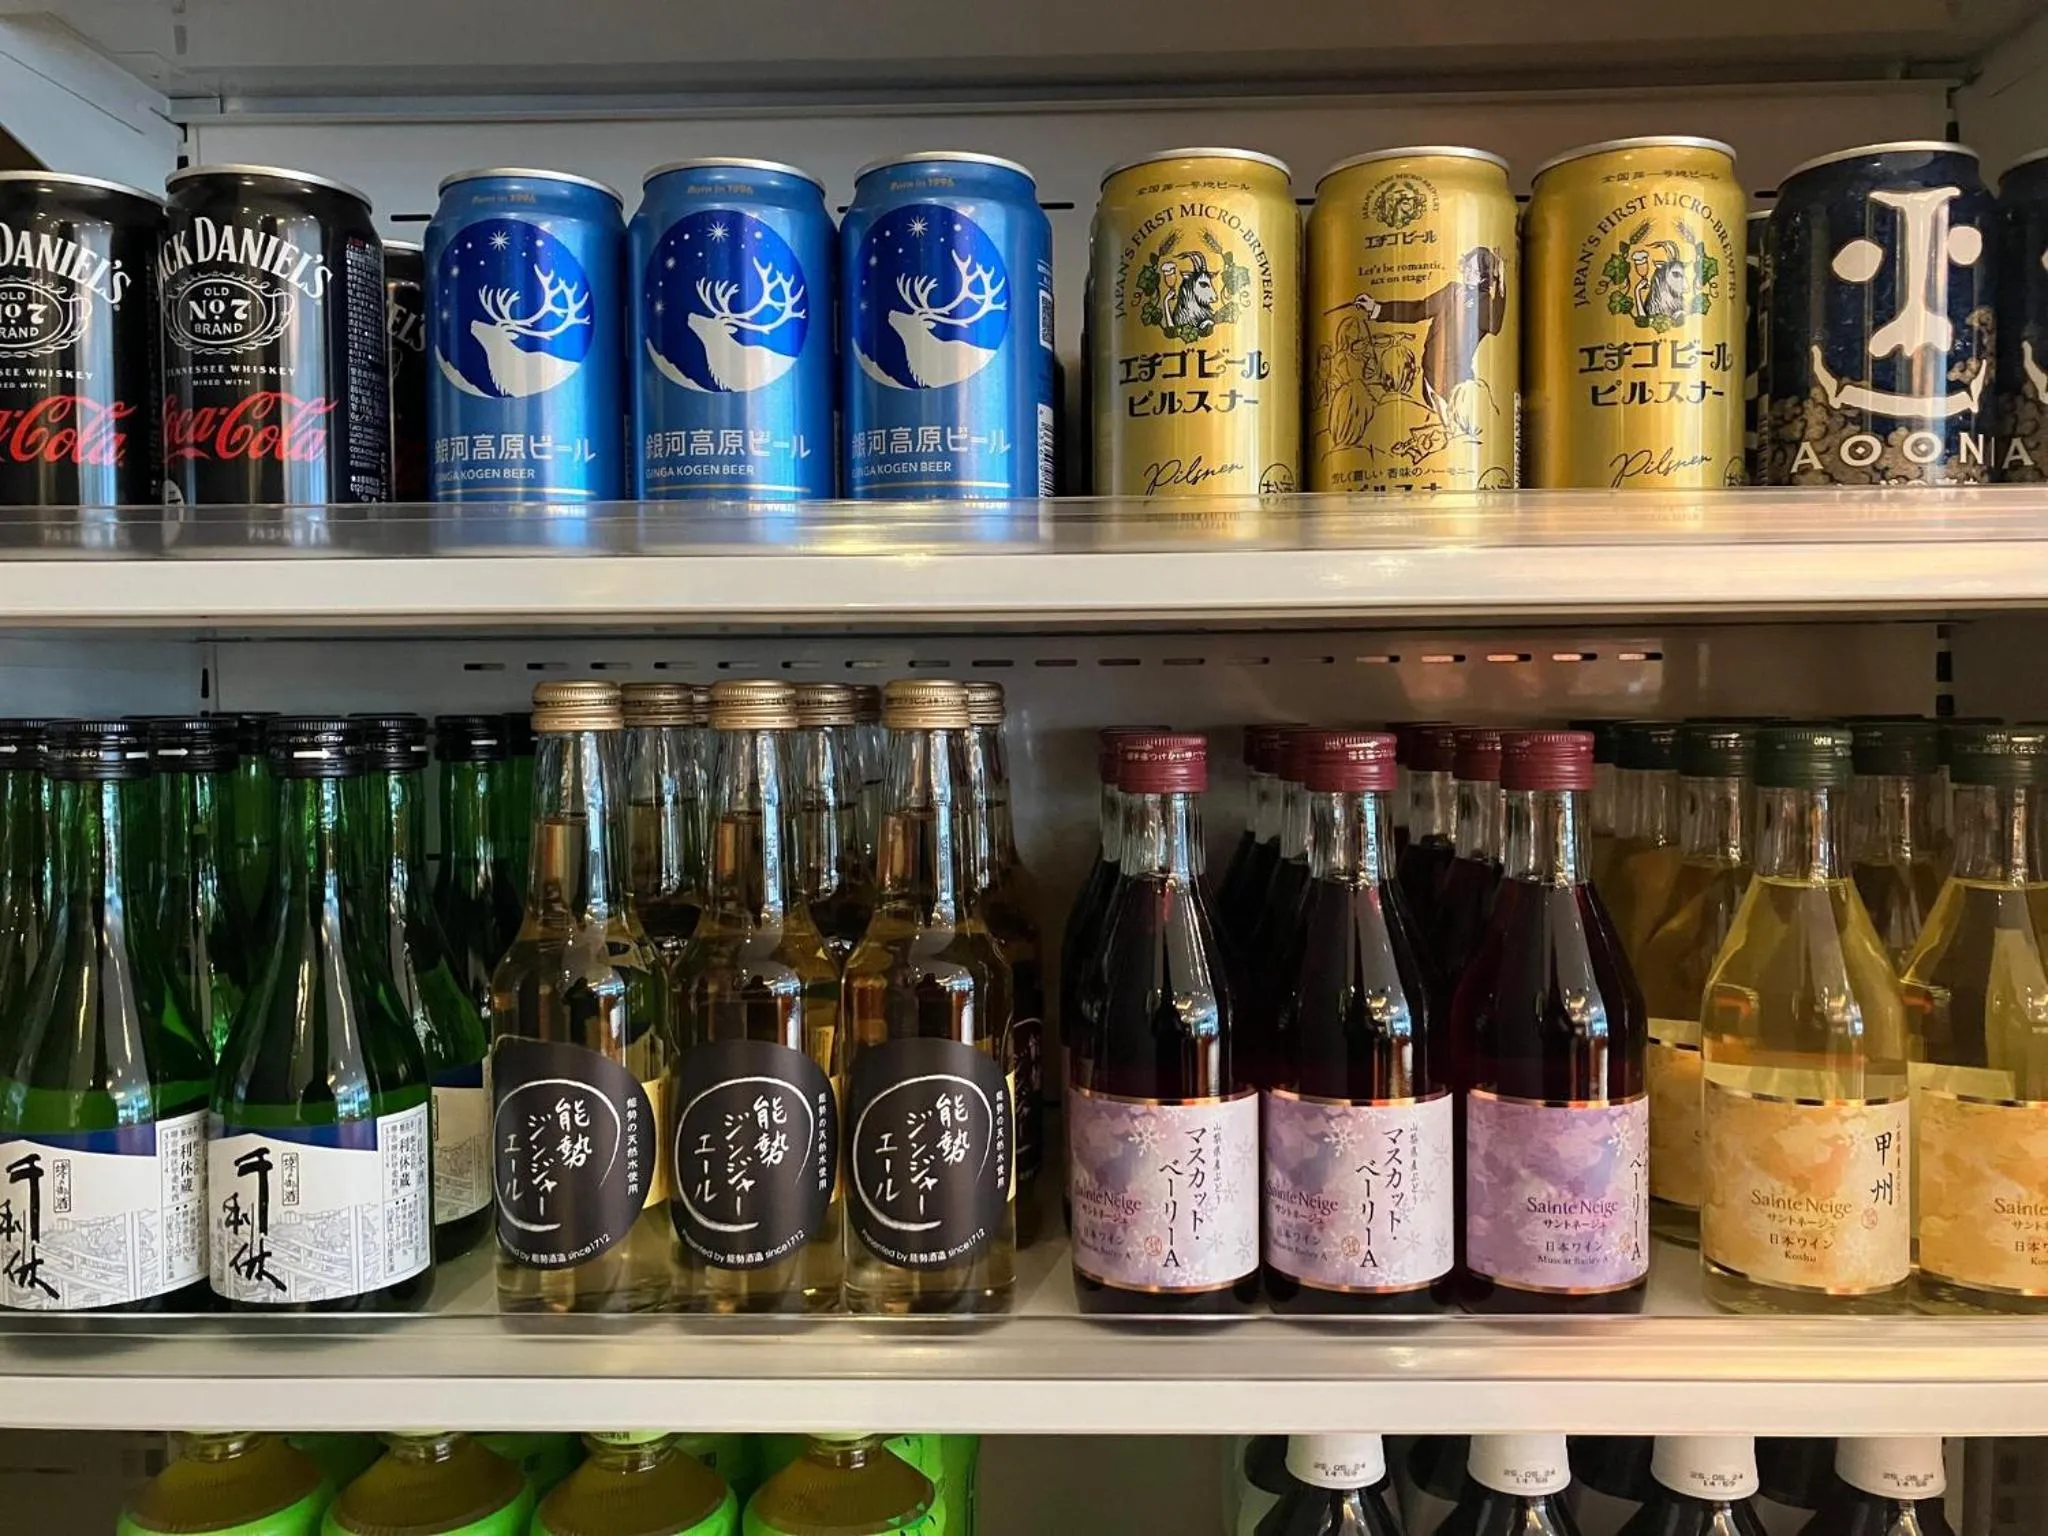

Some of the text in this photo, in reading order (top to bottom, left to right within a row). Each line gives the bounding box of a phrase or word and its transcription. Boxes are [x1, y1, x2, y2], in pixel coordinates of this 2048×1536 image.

[1364, 229, 1438, 250] エチゴビール
[1574, 233, 1601, 309] JAPAN'S
[1597, 196, 1648, 234] FIRST
[194, 216, 334, 300] DANIEL'S
[1114, 249, 1135, 322] JAPAN'S
[1131, 206, 1175, 248] FIRST
[1178, 202, 1274, 316] MICRO-BREWERY
[1358, 264, 1381, 277] Let's
[1383, 263, 1394, 273] be
[203, 286, 230, 297] OLD
[1387, 275, 1400, 284] on
[194, 321, 244, 335] BRAND
[230, 364, 297, 377] WHISKEY
[1119, 349, 1271, 386] エチゴビール
[1579, 339, 1734, 374] エチゴビール
[21, 382, 47, 390] WITH
[26, 367, 94, 381] WHISKEY
[225, 379, 251, 387] WITH
[1127, 389, 1260, 419] ピルスナー
[1591, 380, 1725, 408] ピルスナー
[434, 432, 597, 465] 銀河高原ビール
[646, 428, 812, 460] 銀河高原ビール
[852, 425, 1012, 459] 銀河高原ビール
[460, 468, 501, 480] KOGEN
[503, 467, 536, 480] BEER
[645, 464, 756, 480] GINGA KOGEN BEER
[878, 462, 918, 475] KOGEN
[920, 461, 952, 473] BEER
[1143, 455, 1245, 496] Pilsner
[1610, 446, 1713, 488] Pilsner
[555, 1097, 593, 1170] 能勢
[752, 1094, 790, 1168] 能勢
[936, 1092, 970, 1166] 能勢
[504, 1133, 524, 1201] エール
[528, 1114, 559, 1217] ジンジャー
[694, 1133, 718, 1203] エール
[724, 1111, 756, 1217] ジンジャー
[875, 1132, 900, 1202] エール
[905, 1109, 939, 1216] ジンジャー
[1870, 1131, 1894, 1206] 甲州
[1104, 1190, 1142, 1216] Neige
[1159, 1159, 1185, 1268] ベーリーA
[1299, 1190, 1339, 1217] Neige
[1355, 1159, 1381, 1268] ベーリーA
[1527, 1196, 1619, 1220] Sainte Neige
[1629, 1152, 1642, 1262] ベーリーA
[1751, 1189, 1802, 1212] Sainte
[1804, 1194, 1853, 1221] Neige
[1543, 1219, 1607, 1231] サントネージュ
[1769, 1232, 1834, 1250] 日本ワイン
[714, 1252, 725, 1264] by
[897, 1251, 908, 1263] by
[1546, 1241, 1603, 1252] 日本ワイン
